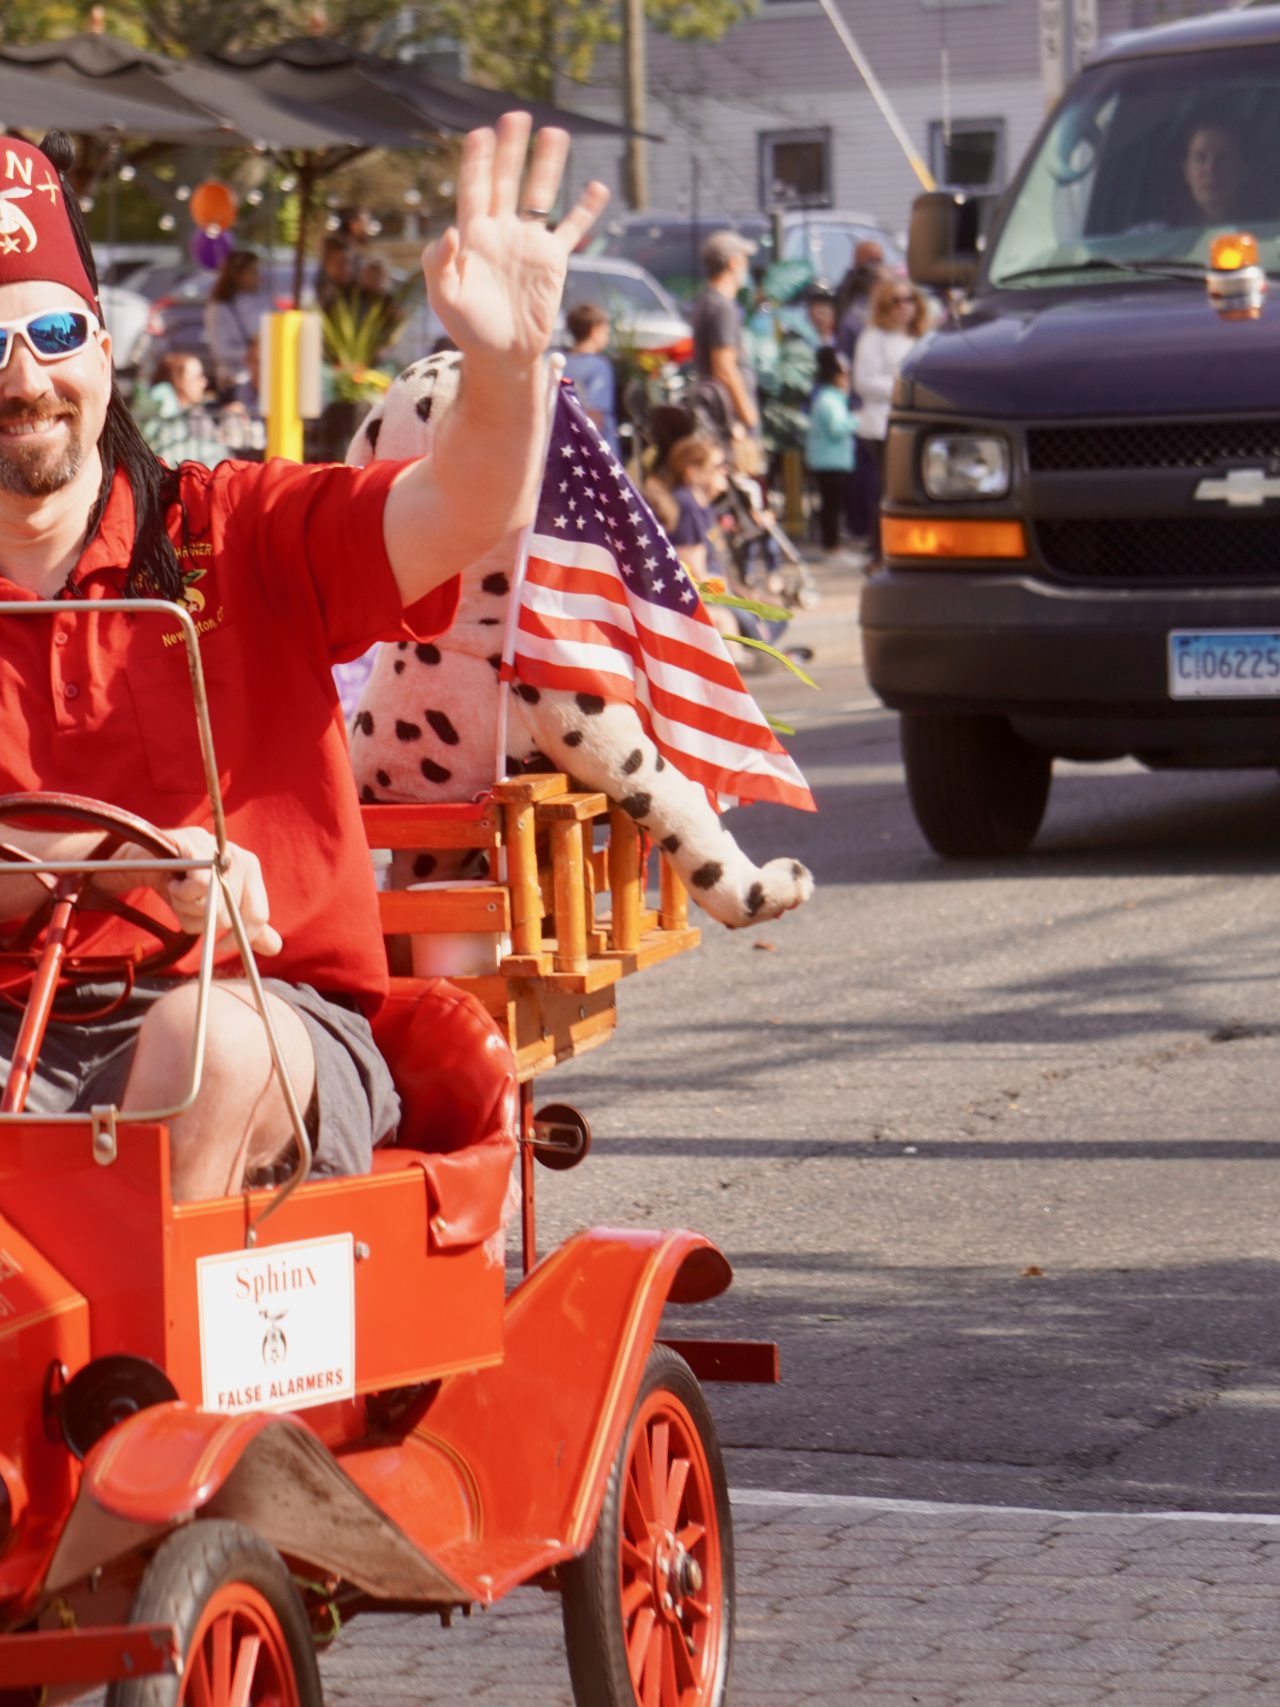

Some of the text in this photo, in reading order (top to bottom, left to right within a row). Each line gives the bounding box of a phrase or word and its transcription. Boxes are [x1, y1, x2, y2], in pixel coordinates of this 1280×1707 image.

[236, 1260, 317, 1303] Sphinx
[218, 1368, 344, 1409] FALSE ALARMERS
